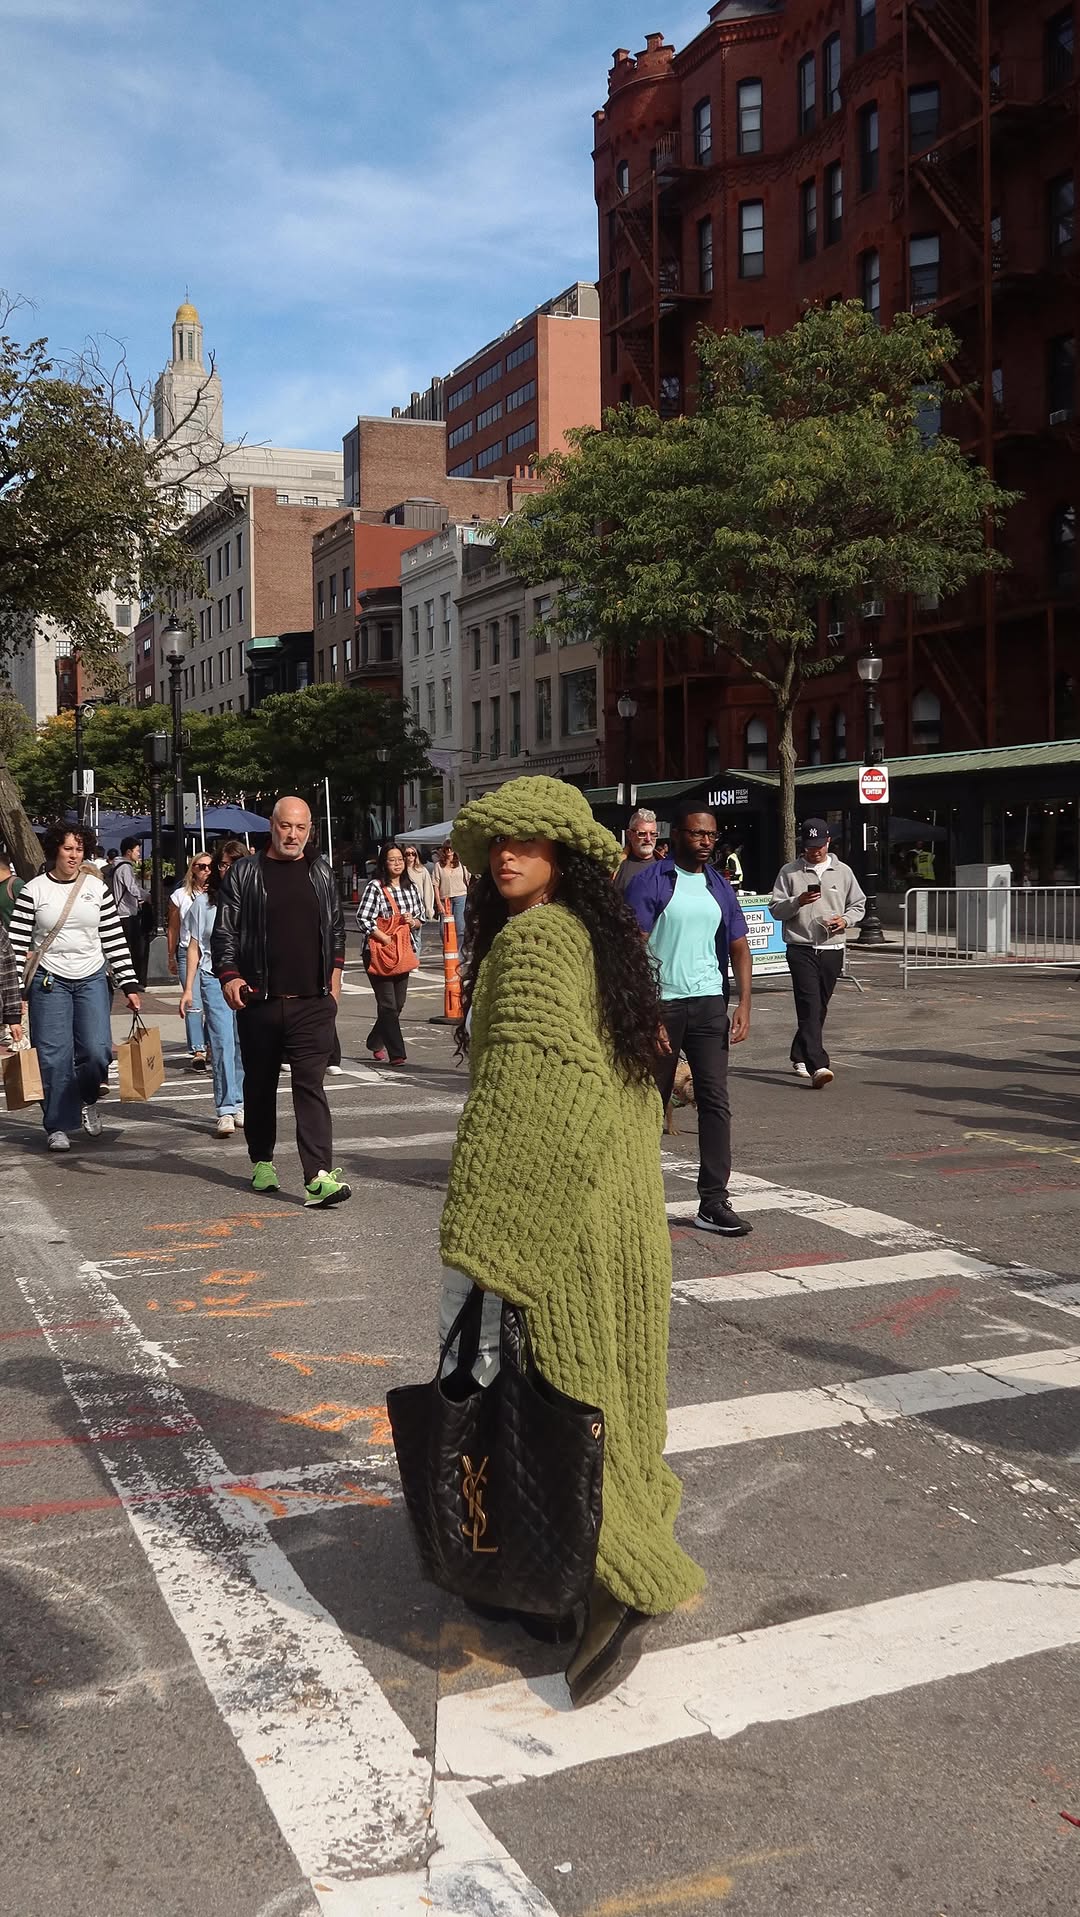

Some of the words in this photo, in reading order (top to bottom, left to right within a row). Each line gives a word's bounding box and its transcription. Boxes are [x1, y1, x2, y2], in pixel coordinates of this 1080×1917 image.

[709, 790, 734, 806] LUSH
[750, 926, 771, 934] BURY
[747, 938, 766, 946] REET
[462, 1455, 499, 1553] YSL
